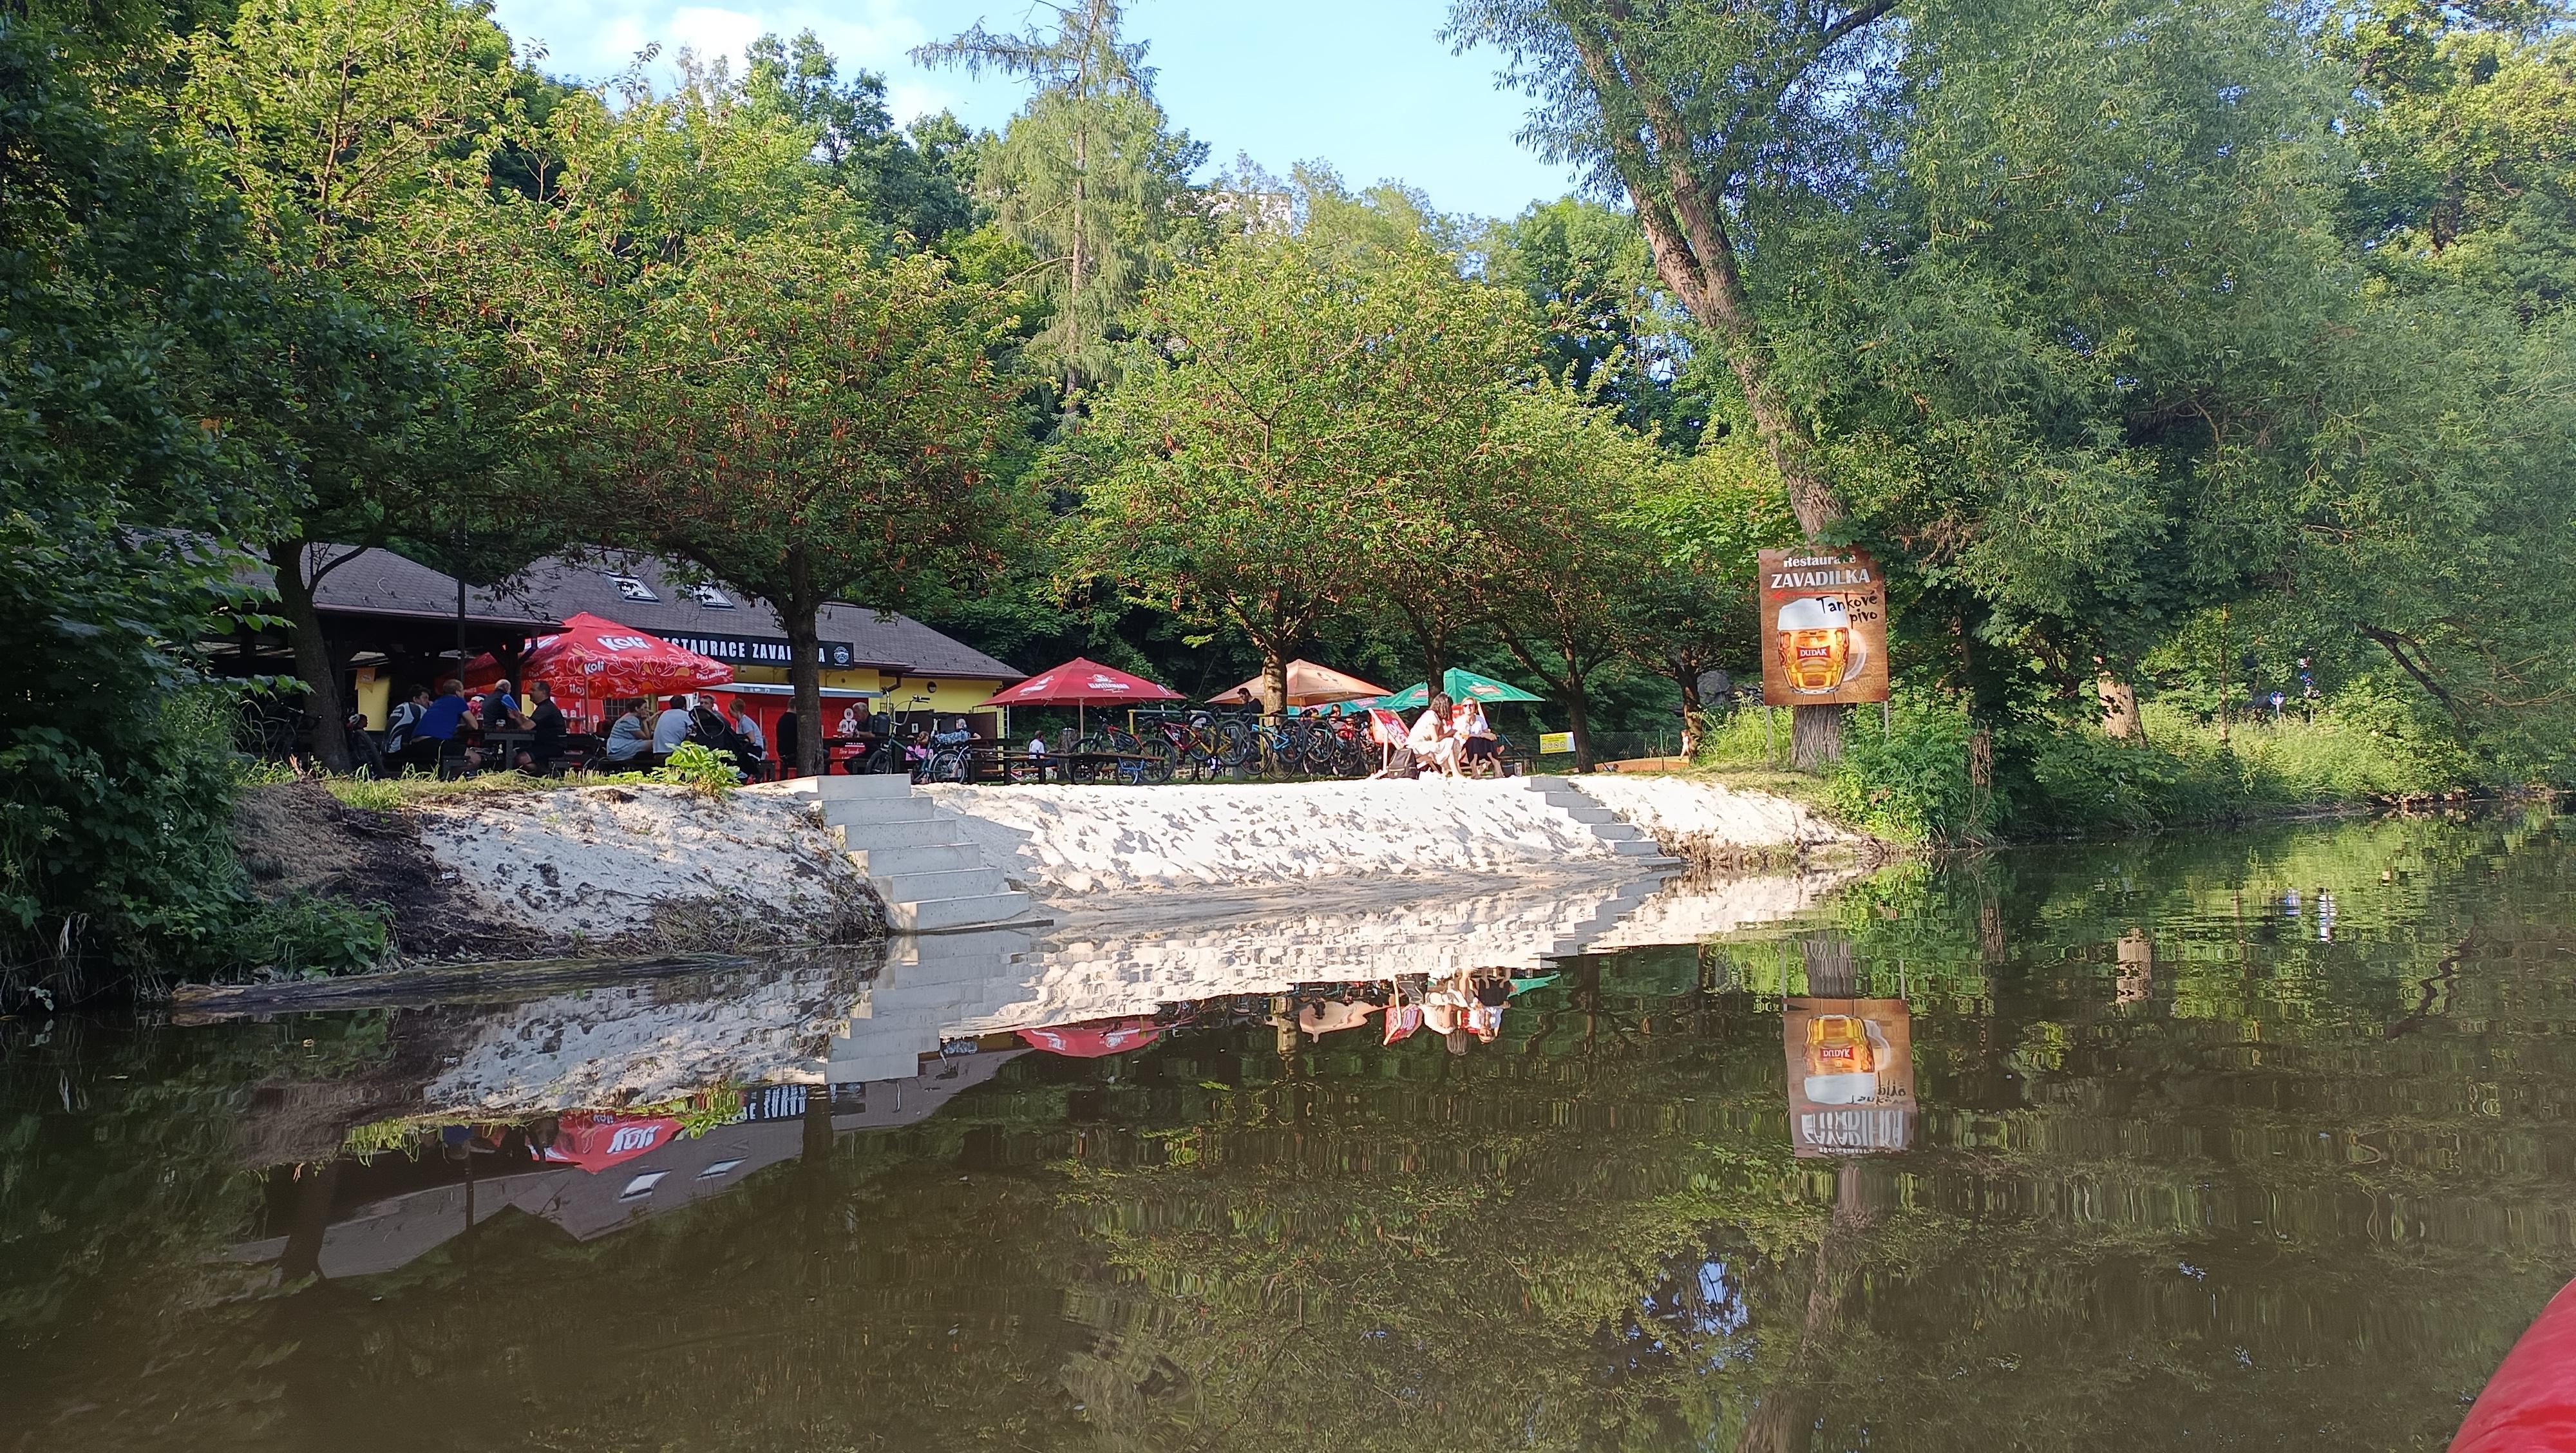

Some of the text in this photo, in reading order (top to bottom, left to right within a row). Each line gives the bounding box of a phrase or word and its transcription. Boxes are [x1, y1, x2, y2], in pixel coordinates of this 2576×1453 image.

[1783, 554, 1856, 567] Restaurae
[1771, 568, 1871, 589] ZAVADILKA
[1816, 591, 1877, 614] Tankové
[1850, 609, 1878, 629] pivo
[597, 636, 652, 651] Koli
[654, 636, 746, 658] STAURACE
[752, 643, 826, 663] ZAVAA
[583, 661, 605, 674] Koli
